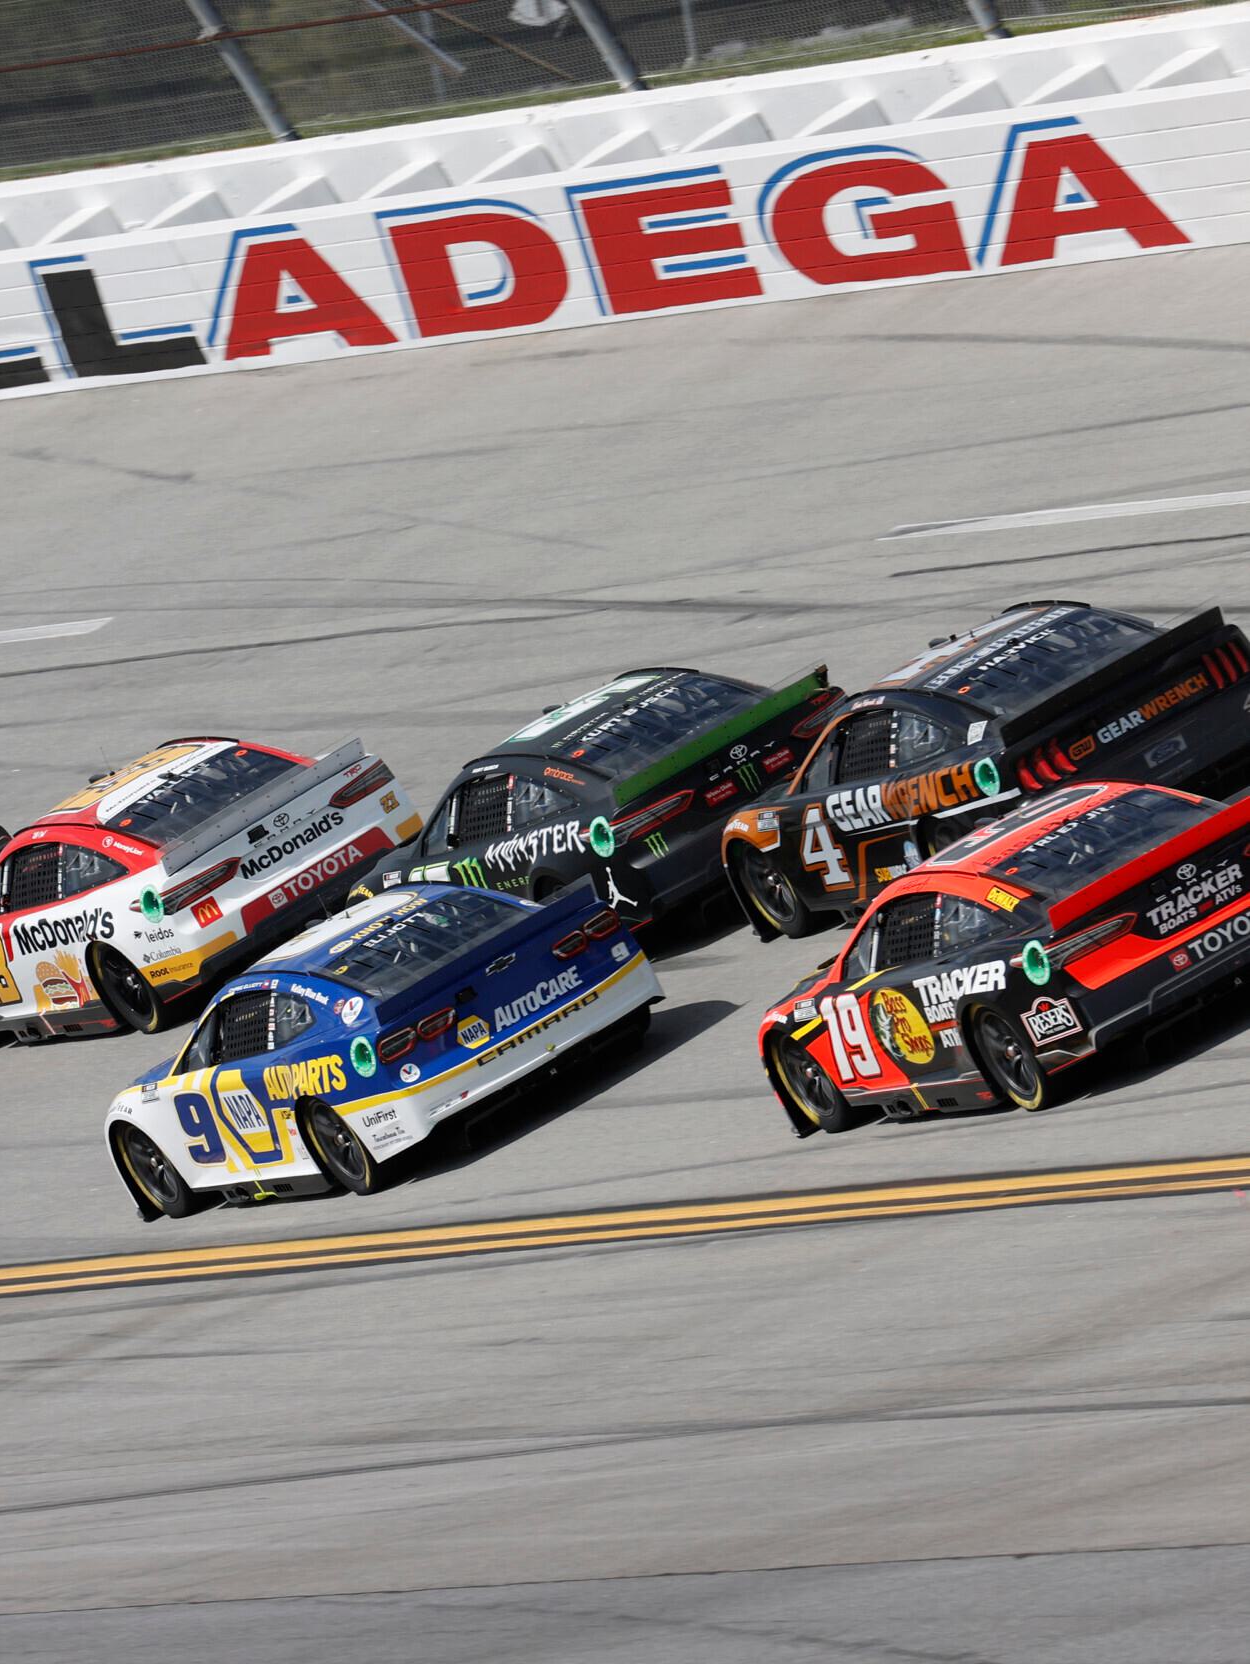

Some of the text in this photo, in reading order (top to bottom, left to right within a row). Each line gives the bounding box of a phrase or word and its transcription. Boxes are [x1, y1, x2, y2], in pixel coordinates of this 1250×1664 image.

[1097, 672, 1209, 744] GEARWRENCH
[379, 791, 400, 814] 23
[240, 811, 344, 879] McDonald's
[484, 820, 586, 871] MONSTER
[800, 803, 855, 891] 4
[283, 845, 363, 898] TOYOTA
[1146, 863, 1244, 926] TRACKER
[144, 928, 175, 943] leidos
[1158, 907, 1198, 934] BOATS
[1188, 911, 1250, 959] TOYO
[150, 947, 182, 962] Columbia
[610, 941, 630, 962] 9
[881, 992, 907, 1015] Bass
[912, 960, 1006, 1006] TRACKER
[460, 1022, 488, 1044] NAPA
[477, 991, 599, 1067] CAMARO
[893, 1016, 912, 1034] Pro
[924, 1002, 956, 1023] BOATS
[819, 993, 883, 1084] 19
[291, 1054, 347, 1100] PARTS
[173, 1092, 227, 1164] 9
[224, 1094, 266, 1130] NAPA
[362, 1109, 397, 1128] UniFirst
